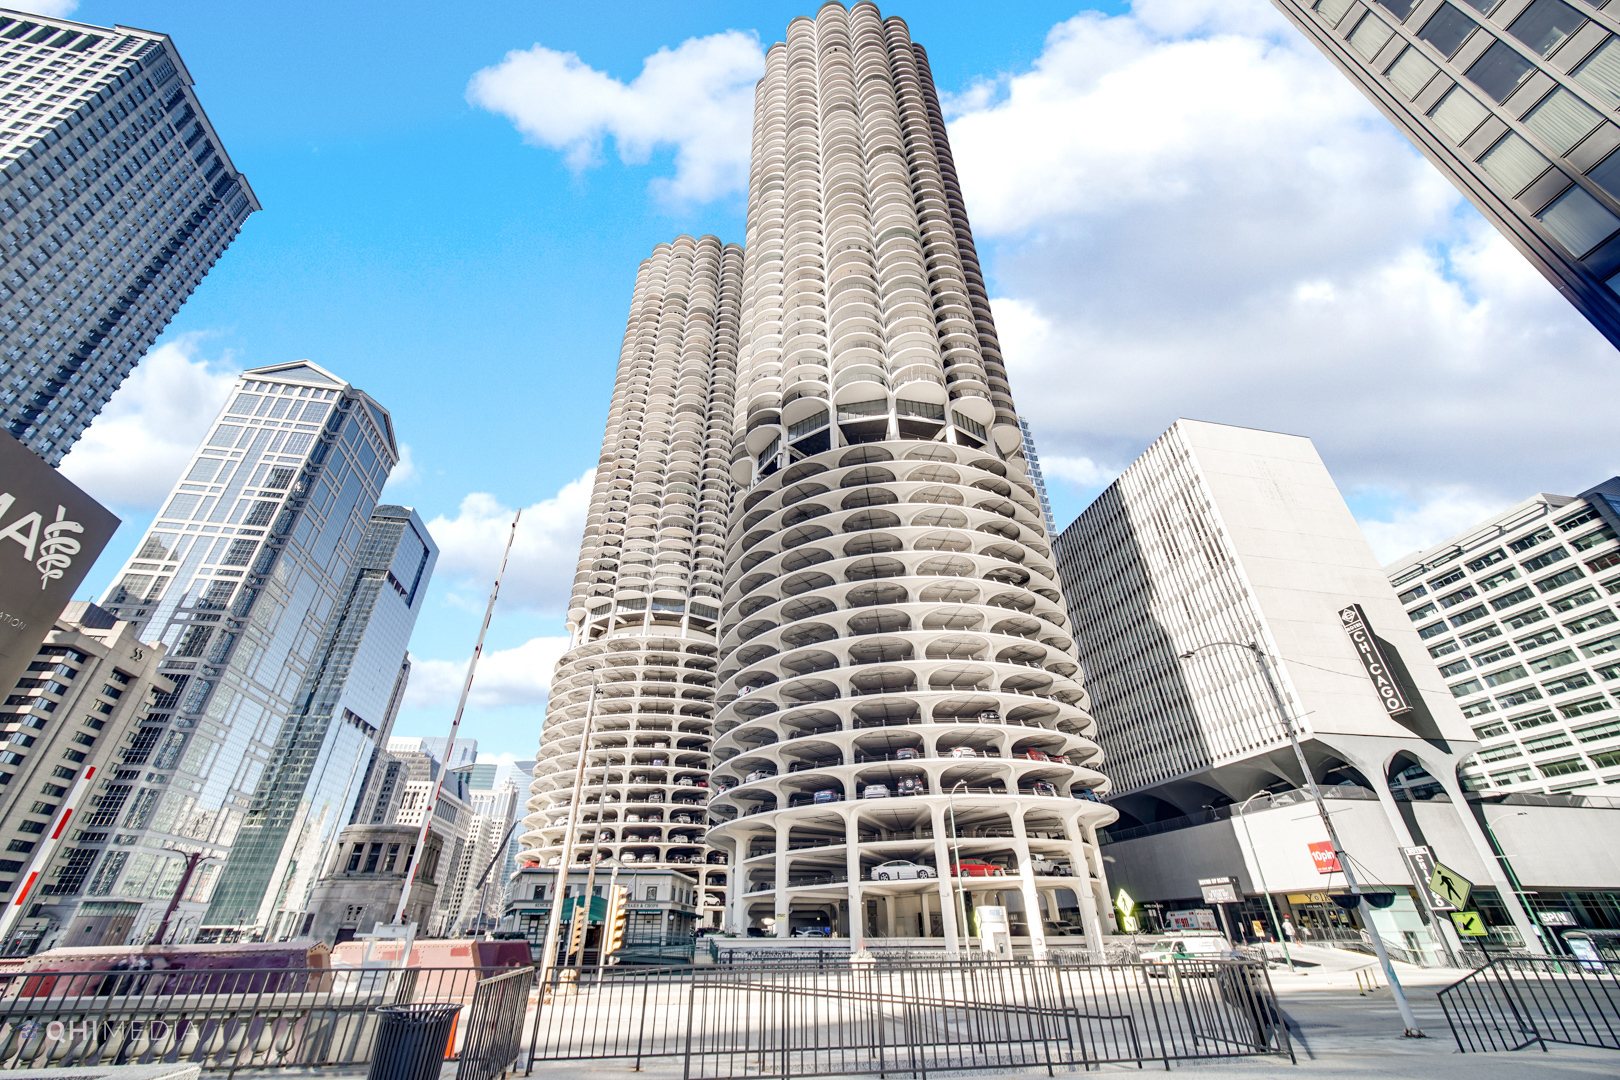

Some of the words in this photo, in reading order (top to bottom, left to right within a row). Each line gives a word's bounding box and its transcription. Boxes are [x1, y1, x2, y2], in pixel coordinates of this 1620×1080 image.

[1353, 631, 1400, 710] CHICAGO
[1311, 850, 1335, 862] 10pin
[1415, 854, 1445, 907] CHICGO
[1540, 911, 1568, 922] SPIN
